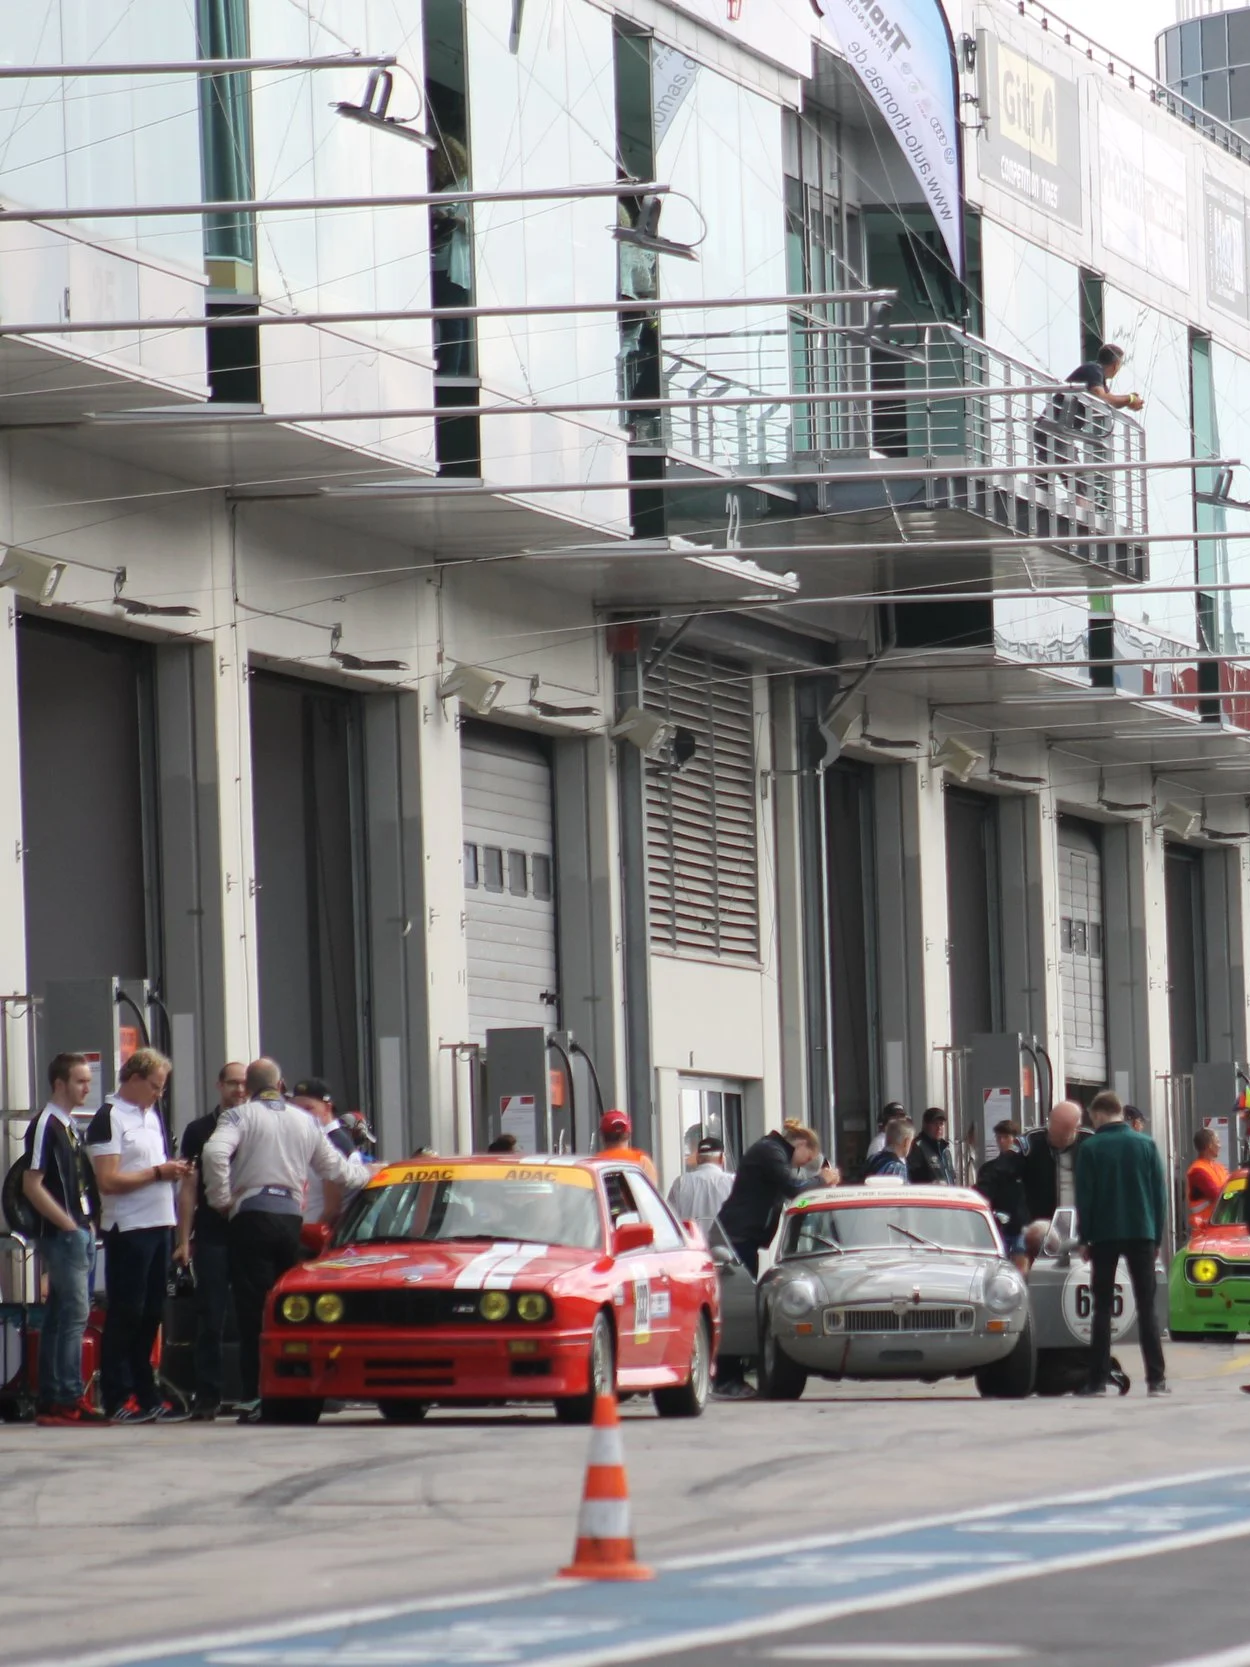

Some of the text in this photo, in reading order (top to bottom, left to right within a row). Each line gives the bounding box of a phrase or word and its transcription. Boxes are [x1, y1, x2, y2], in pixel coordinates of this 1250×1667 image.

[1003, 70, 1036, 139] Giti
[402, 1170, 454, 1183] ADAC
[505, 1169, 558, 1182] ADAC
